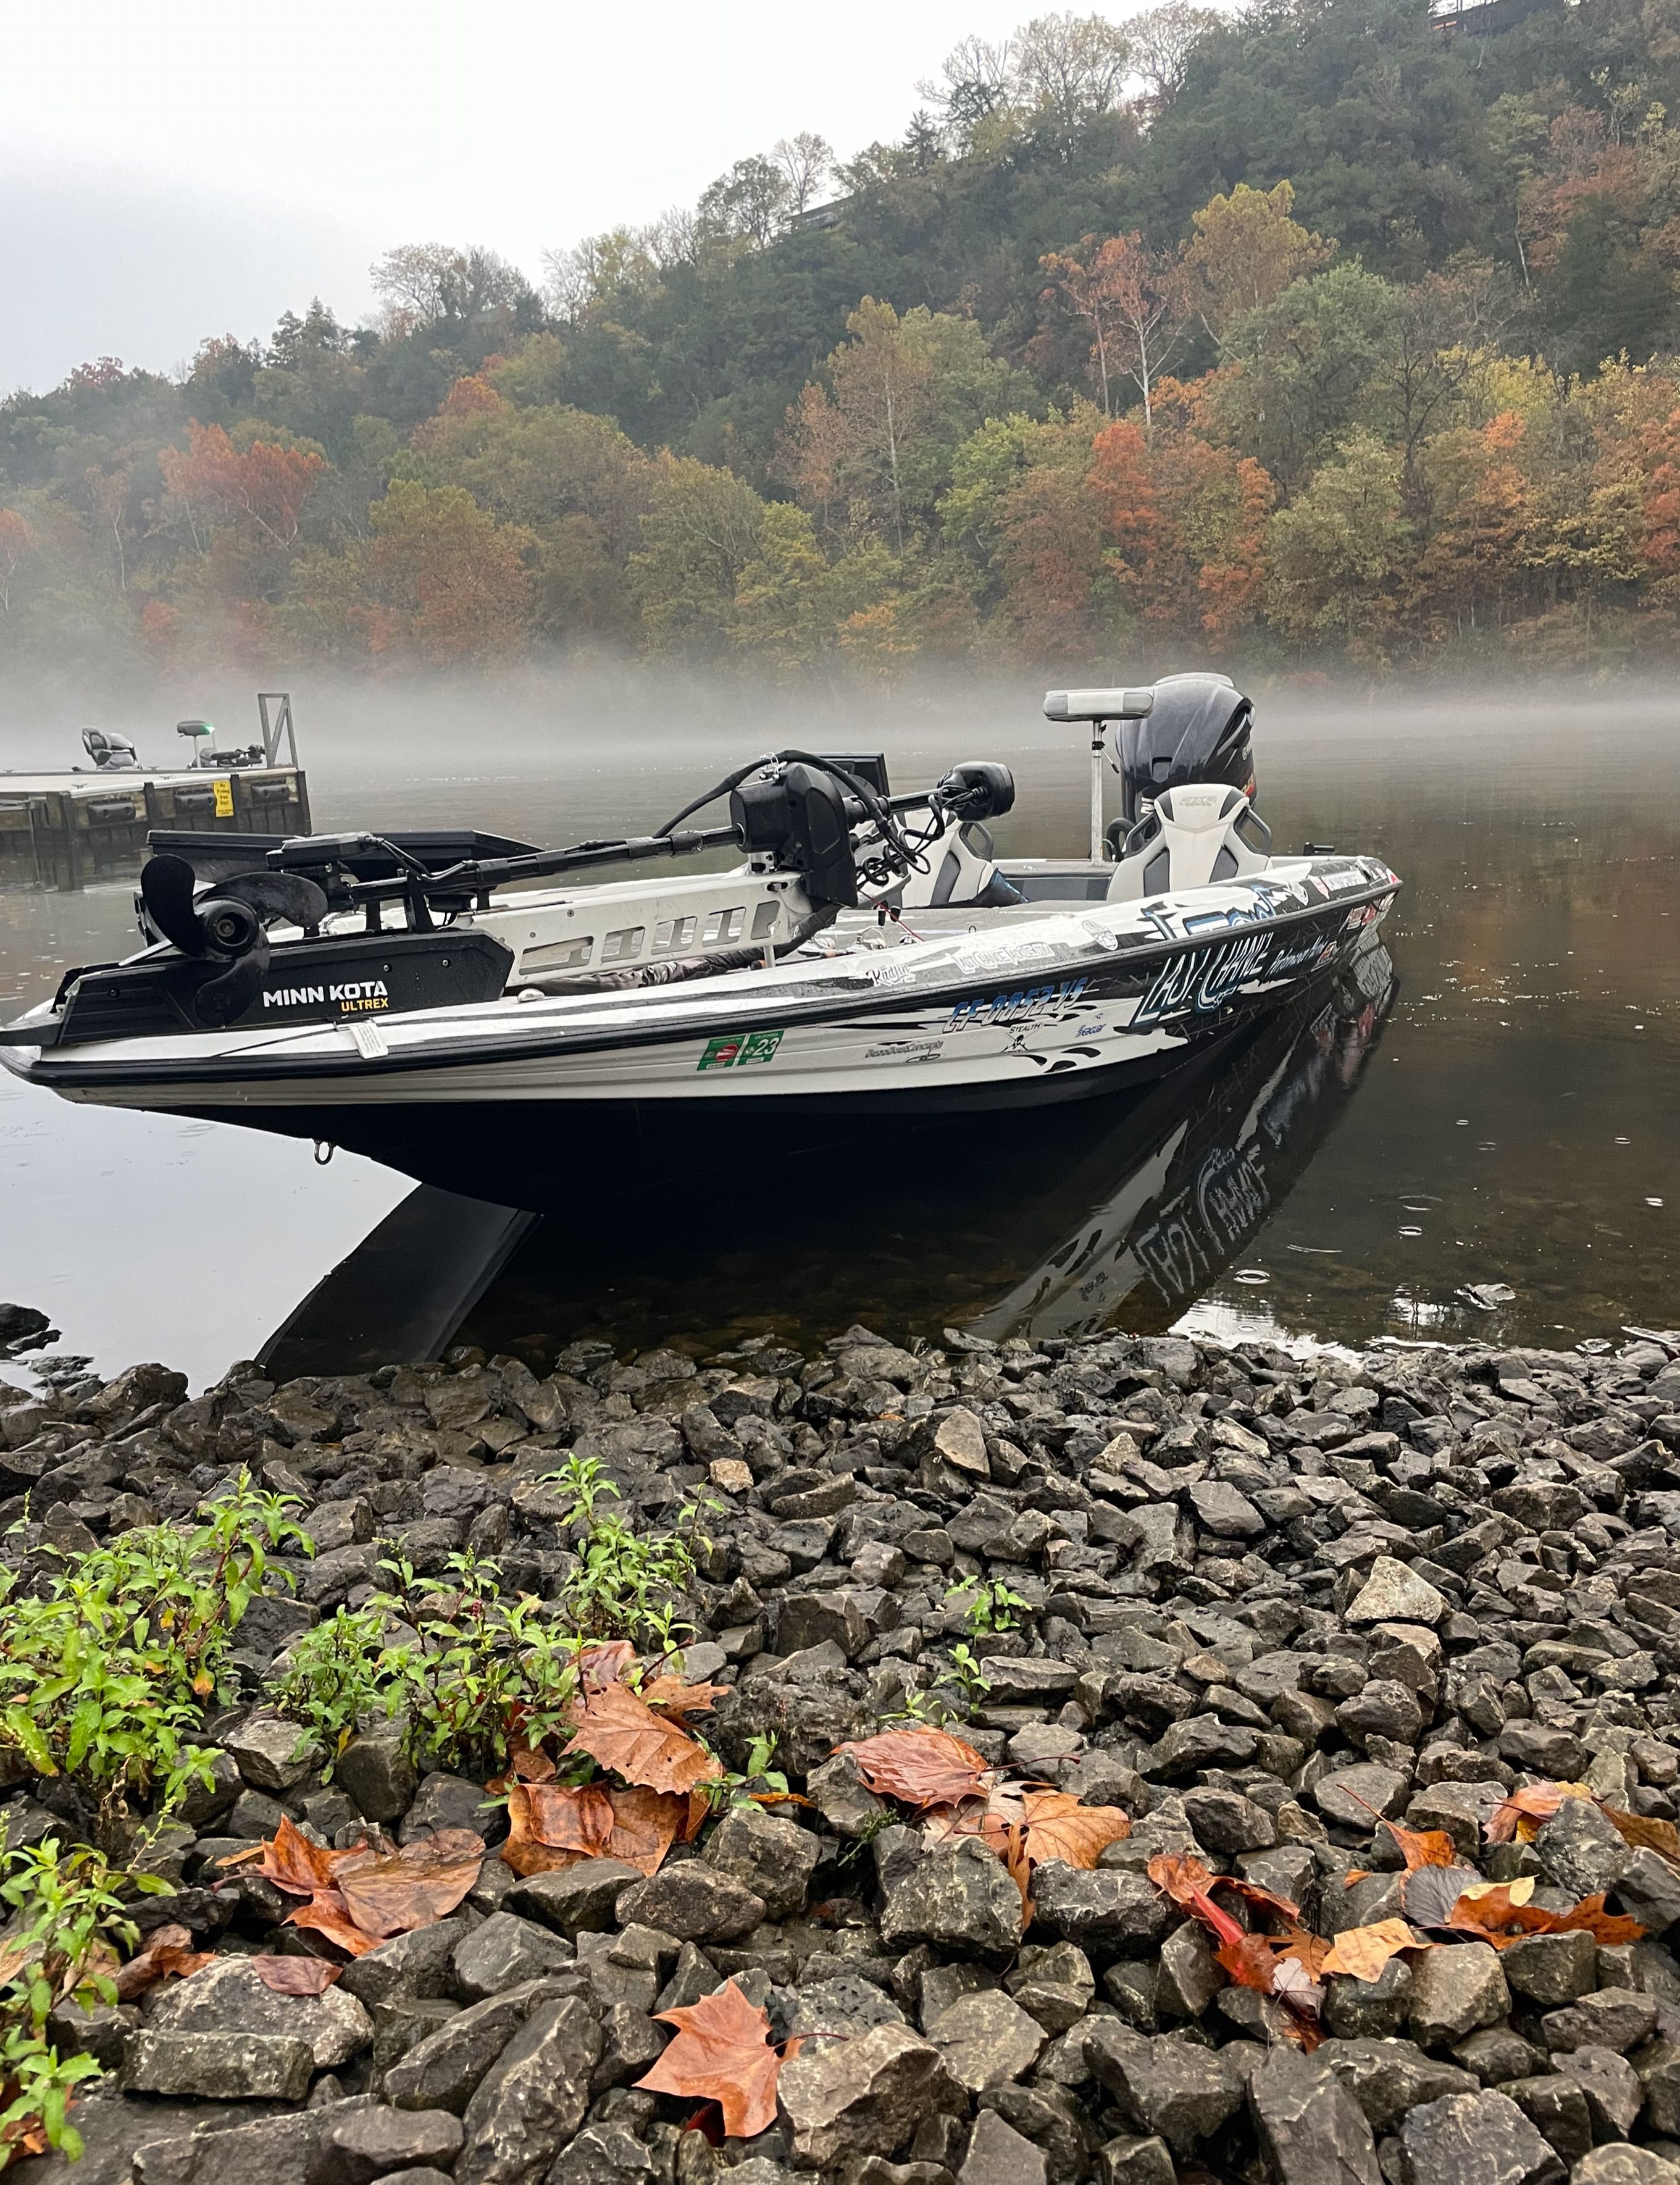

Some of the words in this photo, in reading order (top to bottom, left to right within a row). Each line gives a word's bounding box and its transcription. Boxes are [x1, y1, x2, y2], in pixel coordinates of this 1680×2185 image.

[262, 986, 325, 1007] MINN
[329, 980, 388, 1001] KOTA
[341, 997, 389, 1012] ULTREX
[942, 998, 985, 1033] CF
[981, 984, 1055, 1026] 0852
[752, 1037, 780, 1057] 23
